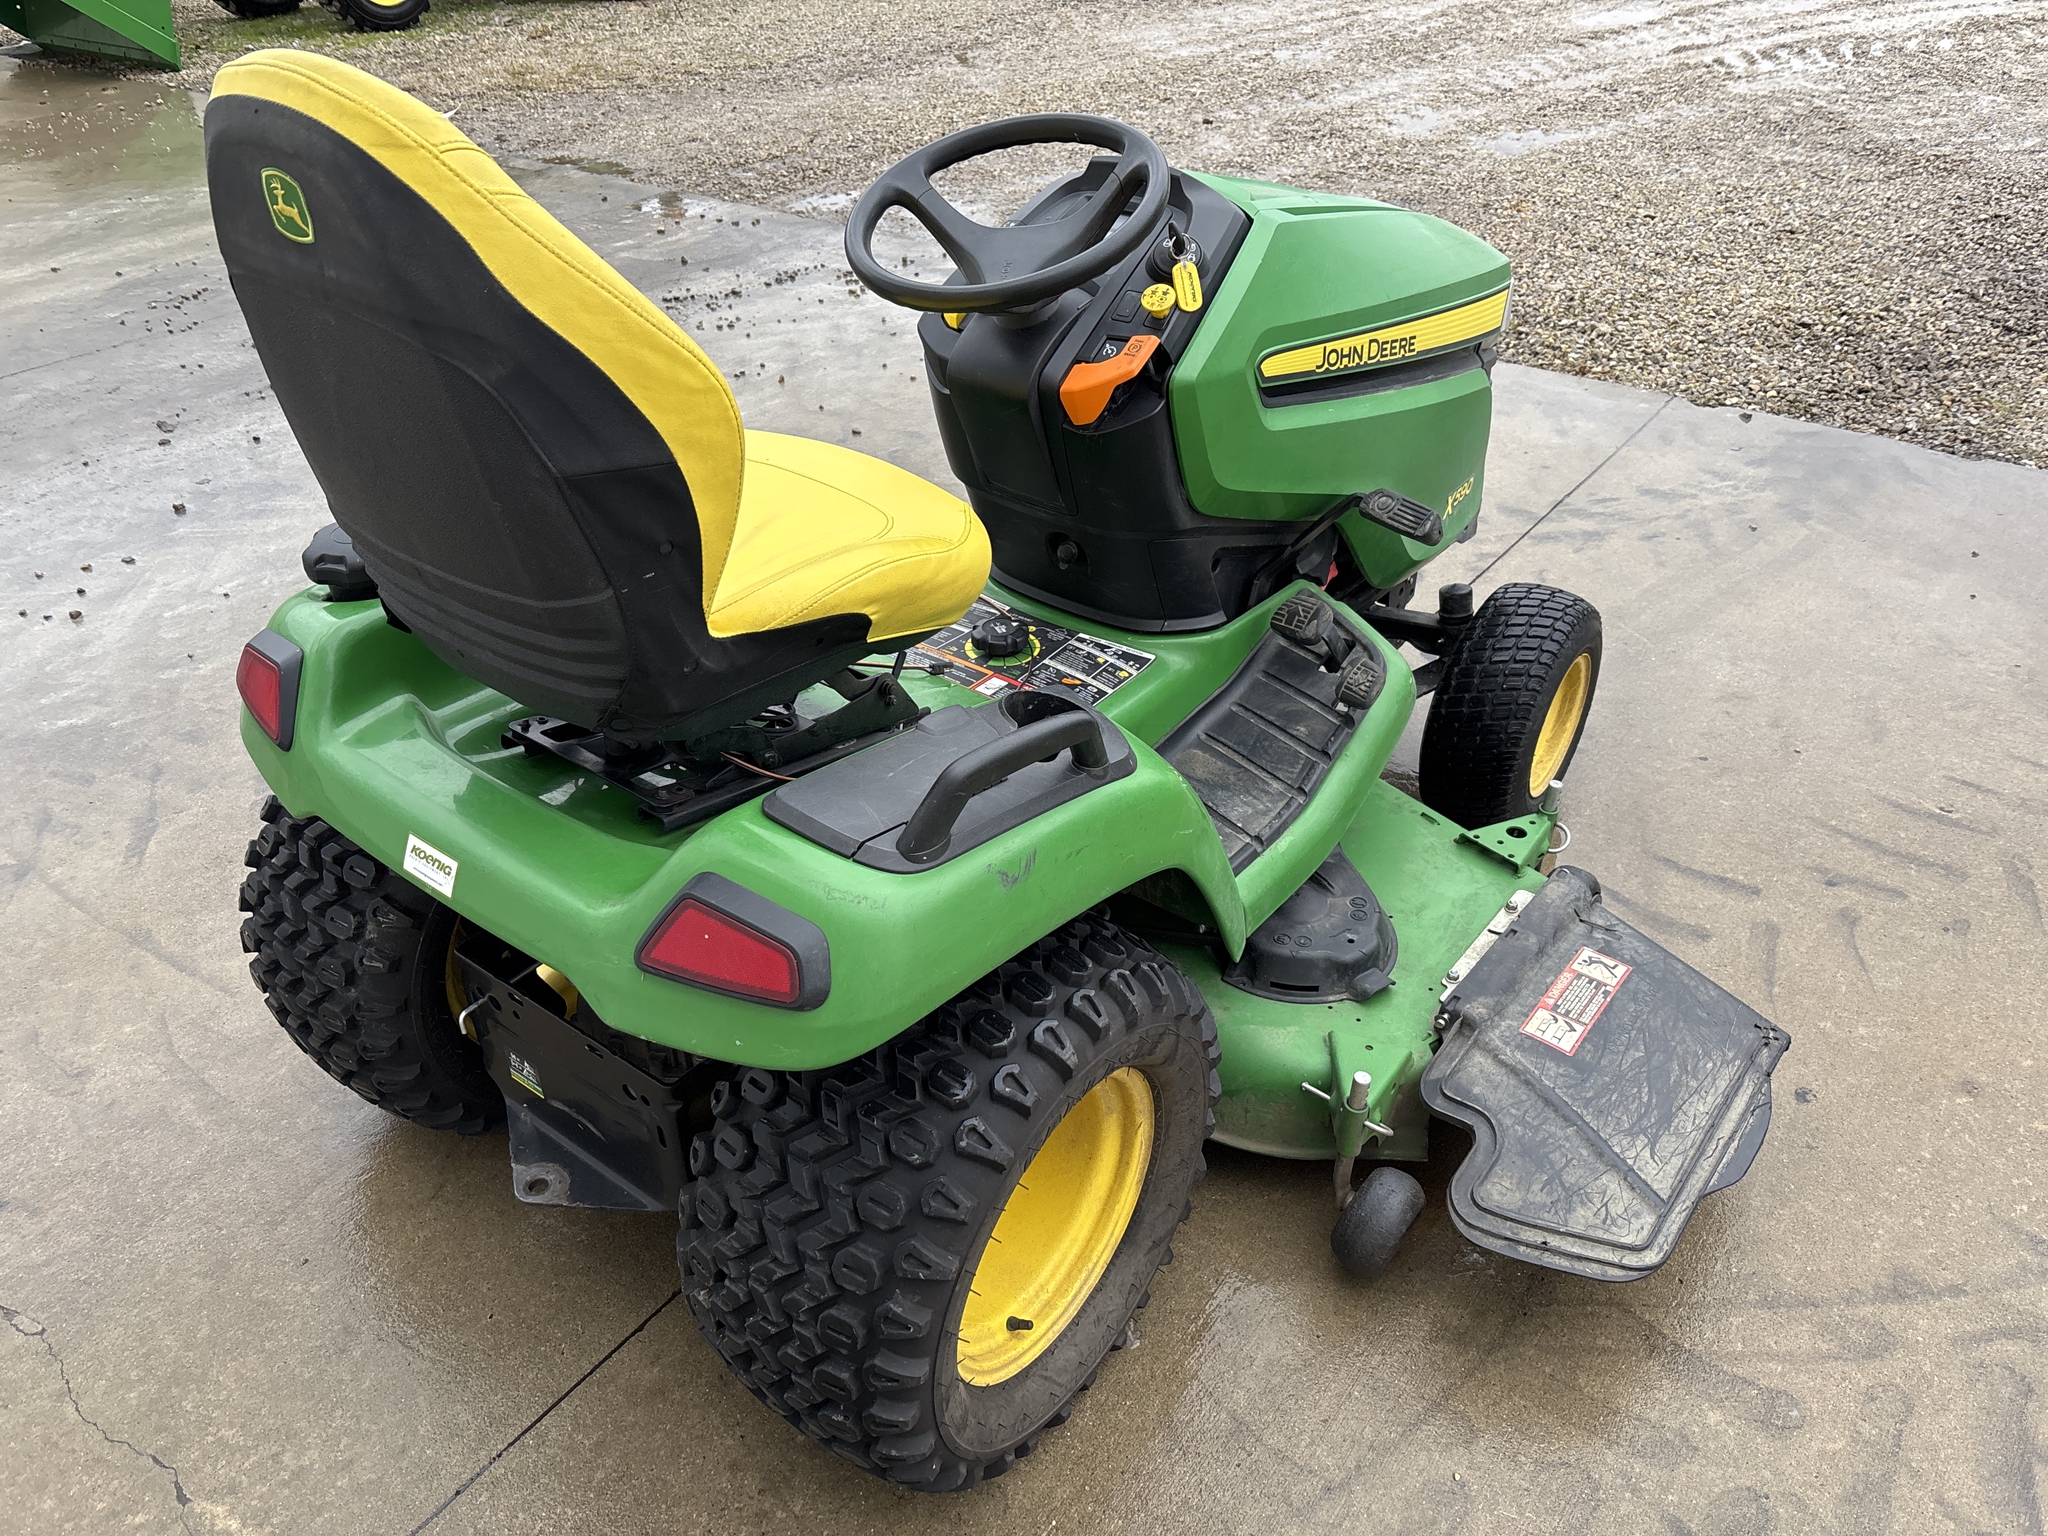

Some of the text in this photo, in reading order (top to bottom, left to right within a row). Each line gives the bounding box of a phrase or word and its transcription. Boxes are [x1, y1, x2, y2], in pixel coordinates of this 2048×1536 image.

[1315, 335, 1417, 370] JOHN DEERE
[1443, 477, 1474, 520] X590
[1547, 971, 1575, 999] DANGER
